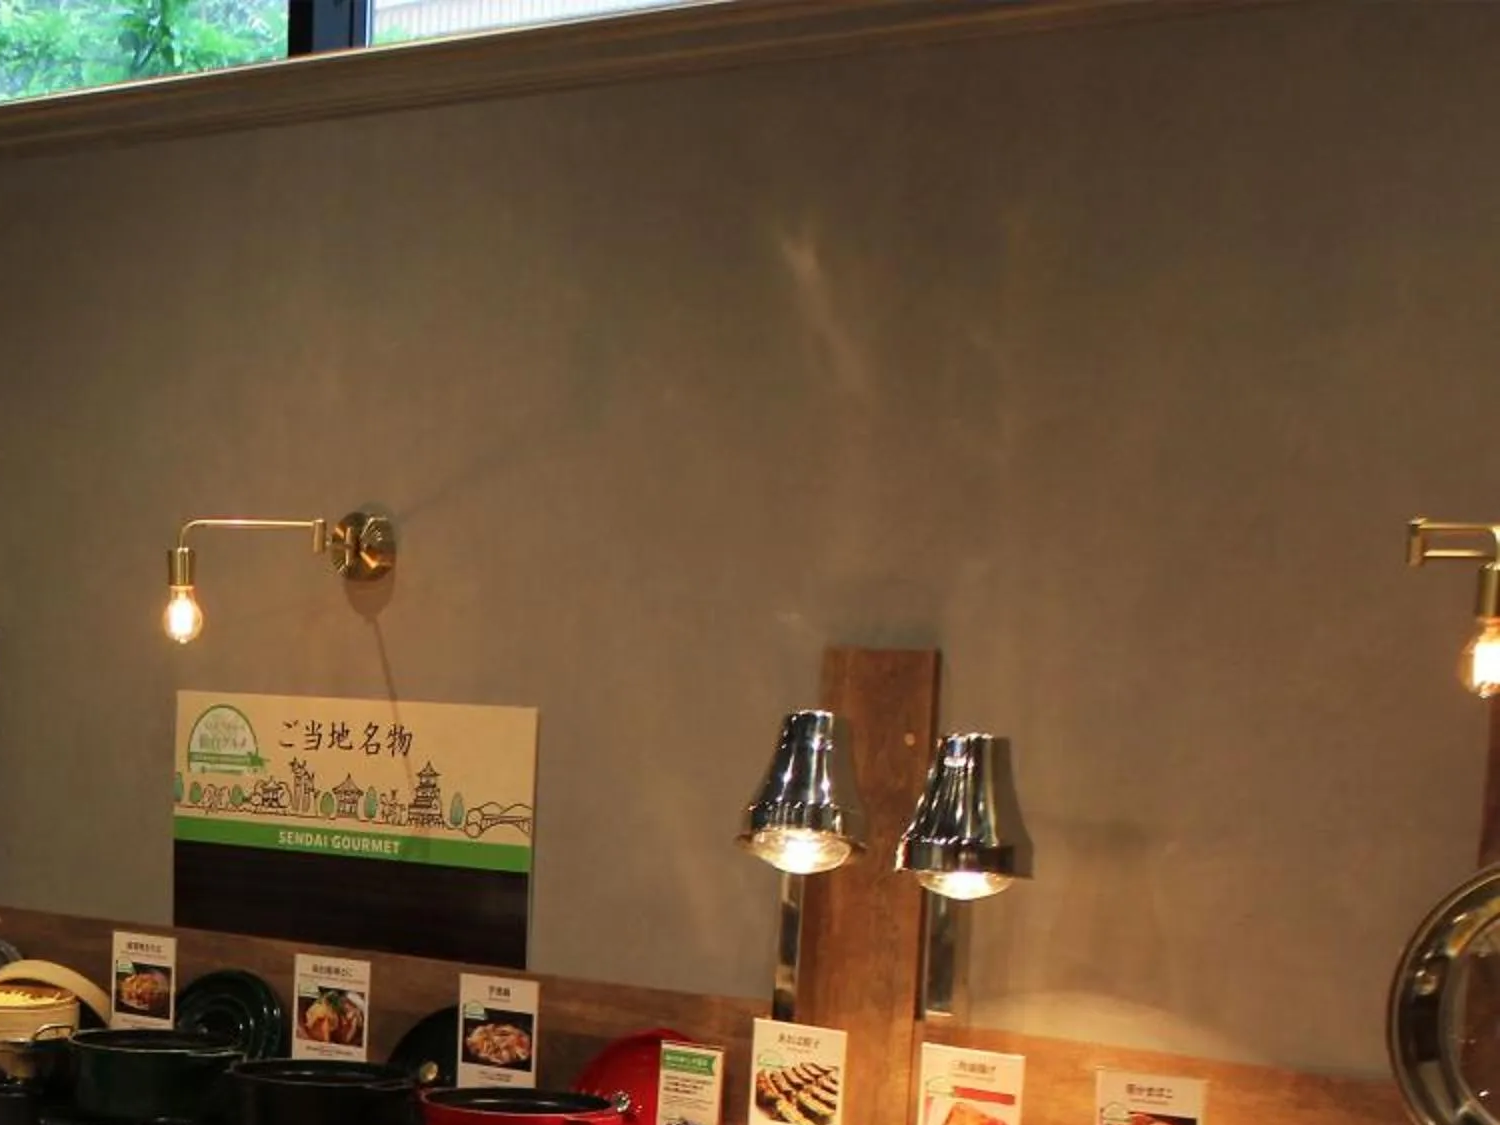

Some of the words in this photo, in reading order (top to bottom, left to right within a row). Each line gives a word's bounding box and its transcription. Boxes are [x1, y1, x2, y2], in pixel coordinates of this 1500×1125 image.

[279, 719, 413, 757] ご当地名物
[279, 831, 328, 848] SENDAI
[331, 835, 400, 854] GOURMET
